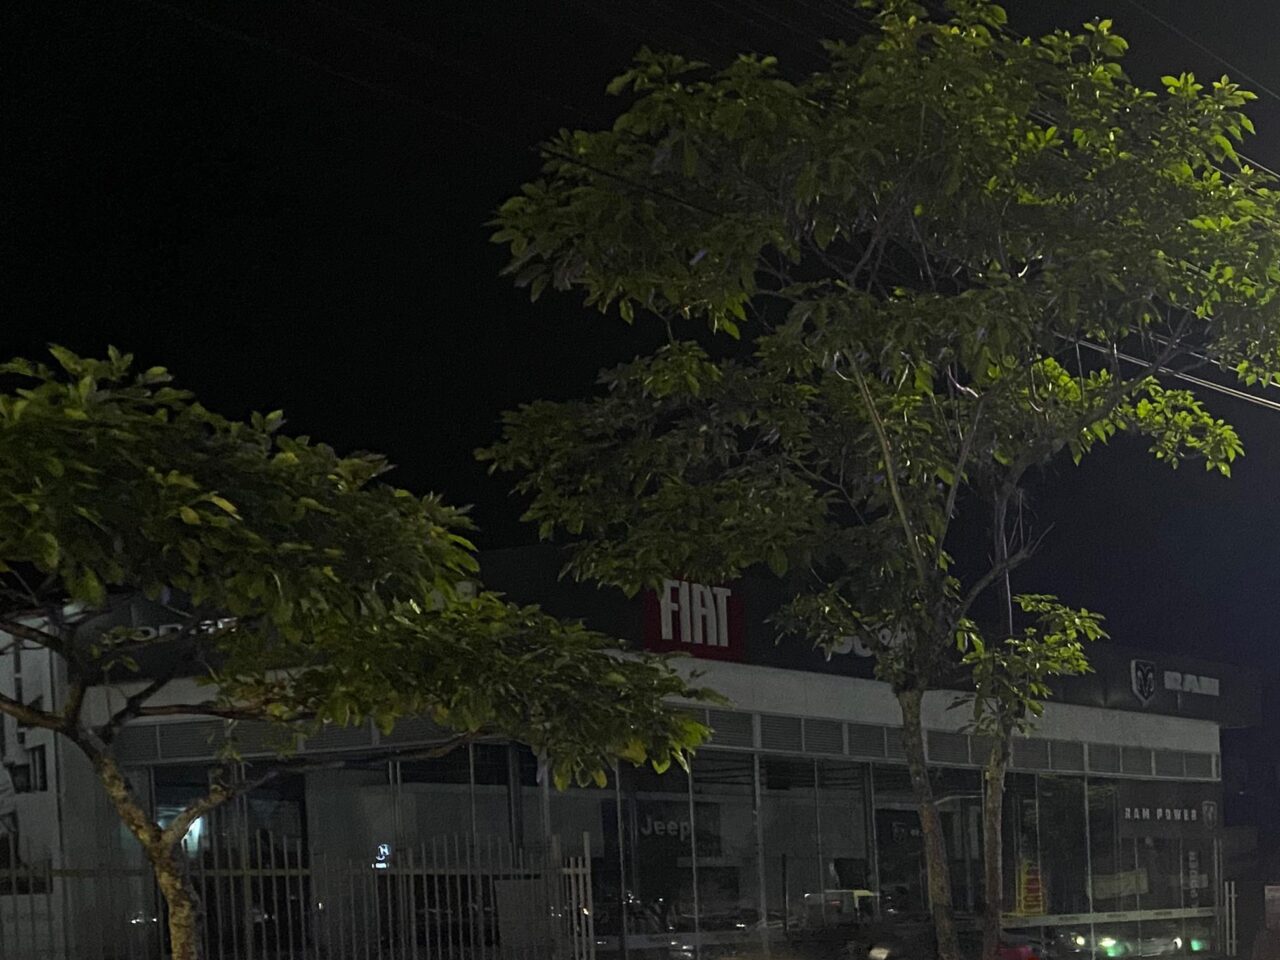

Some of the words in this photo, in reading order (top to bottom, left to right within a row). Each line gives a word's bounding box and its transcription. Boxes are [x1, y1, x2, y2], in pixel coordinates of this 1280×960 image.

[660, 578, 732, 647] FIAT
[1124, 807, 1150, 819] RAM
[641, 814, 691, 842] Jeep
